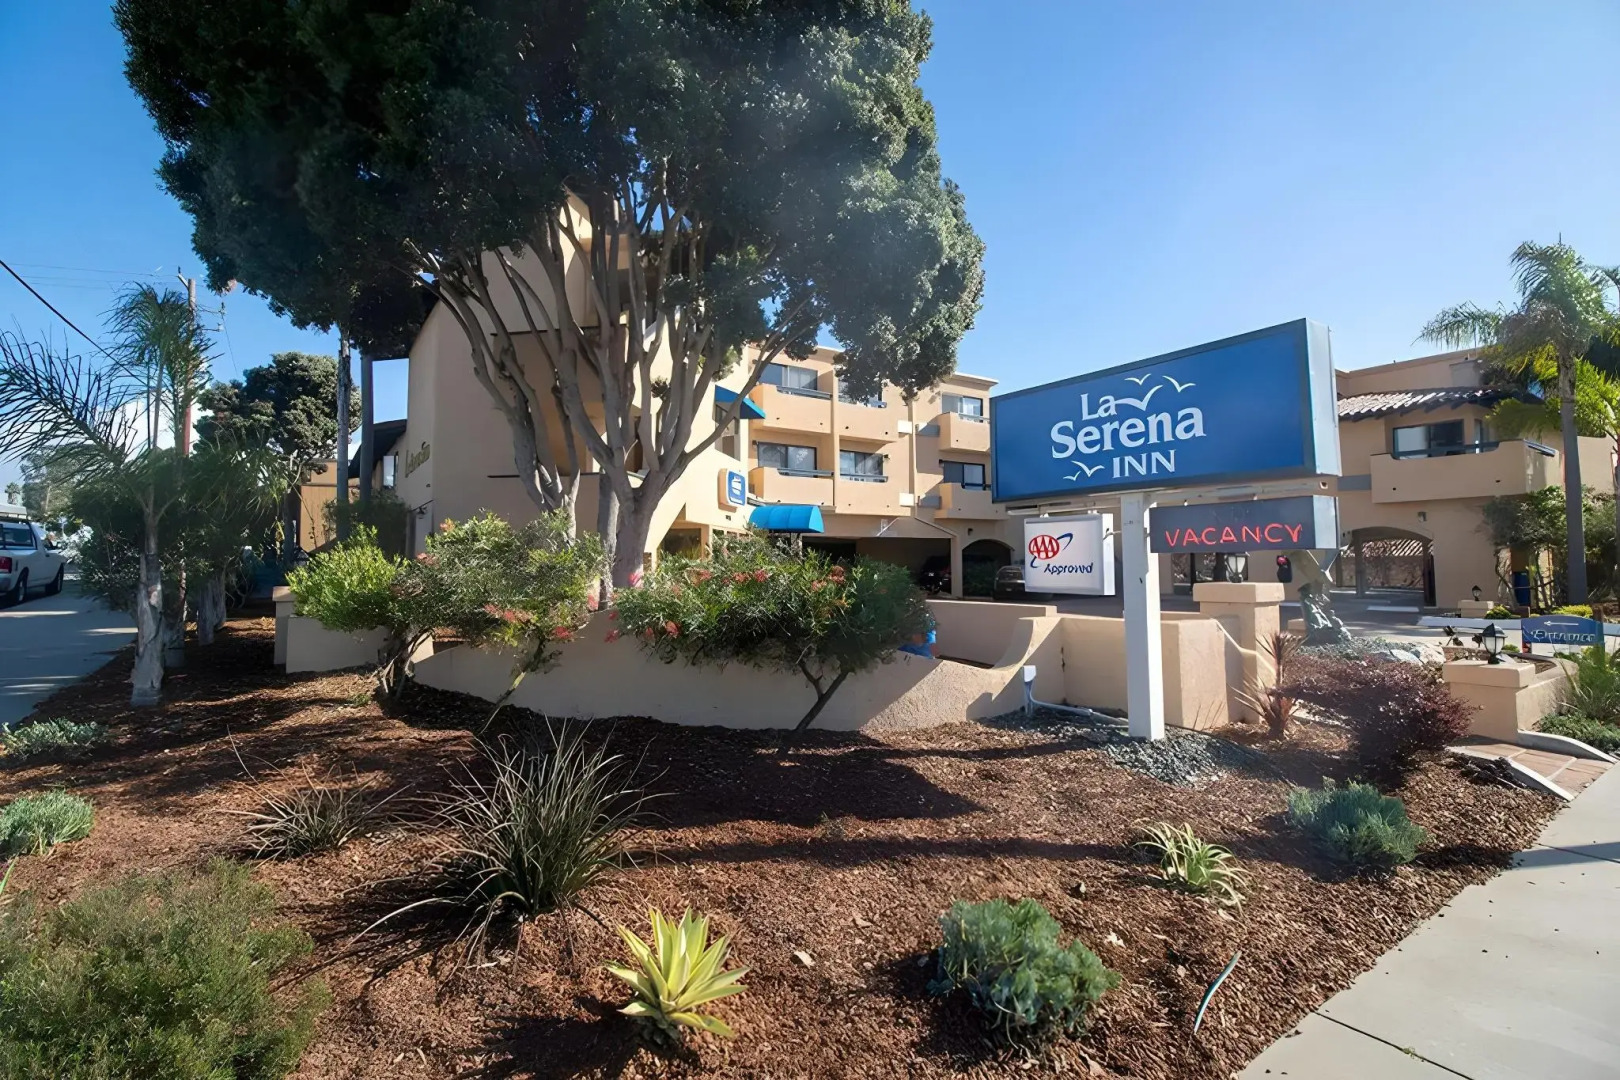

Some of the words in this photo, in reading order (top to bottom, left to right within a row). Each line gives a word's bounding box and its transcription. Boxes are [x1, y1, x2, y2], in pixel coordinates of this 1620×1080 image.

[1080, 393, 1118, 421] La
[1050, 406, 1207, 459] Serena
[1112, 449, 1177, 479] INN
[1029, 535, 1060, 560] AAA
[1165, 523, 1303, 547] VACANCY
[1043, 562, 1094, 576] Approved
